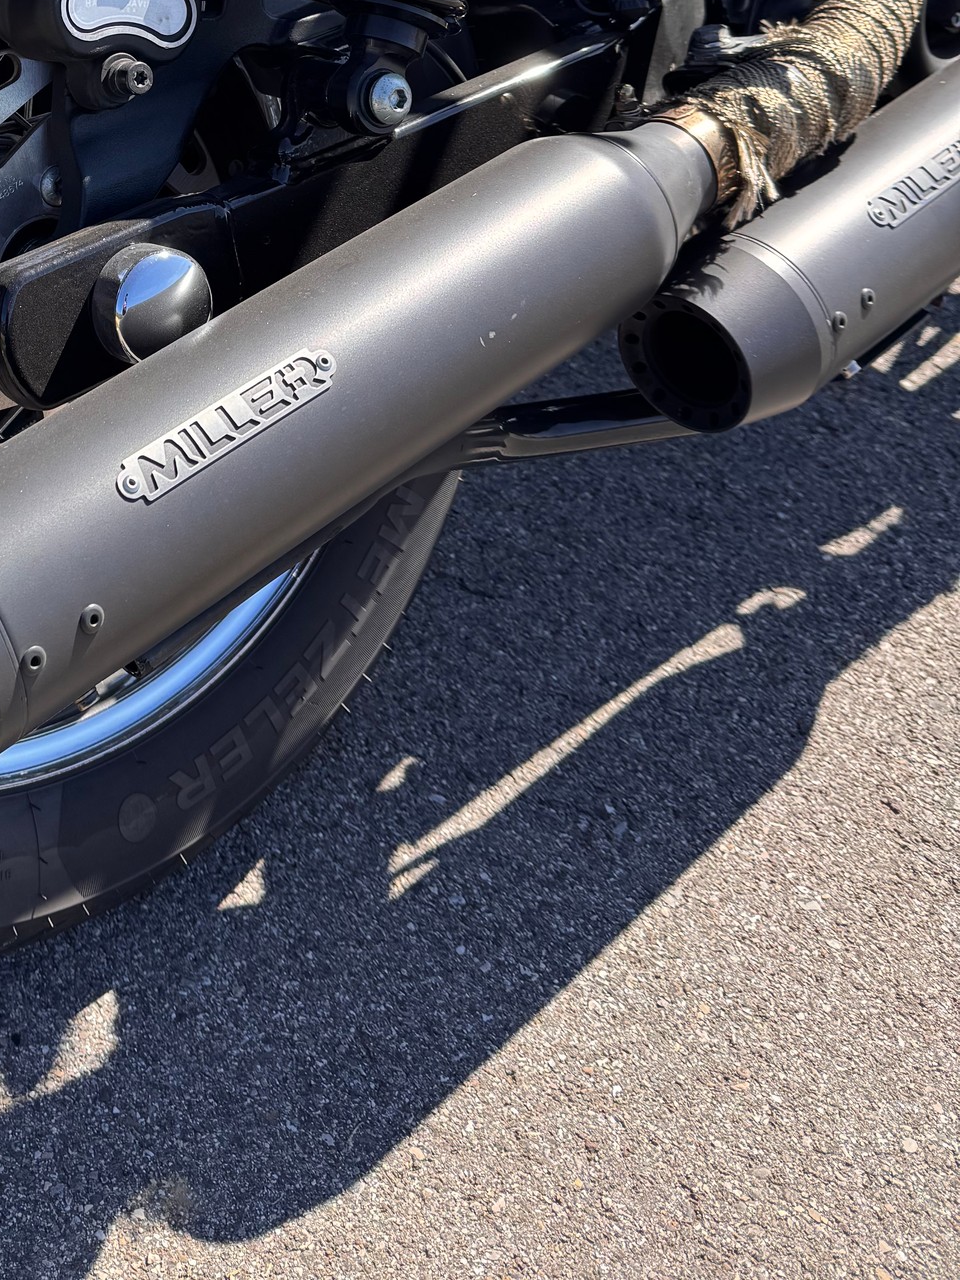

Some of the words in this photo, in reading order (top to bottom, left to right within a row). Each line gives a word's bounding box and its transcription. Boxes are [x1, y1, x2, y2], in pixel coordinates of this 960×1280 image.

[877, 139, 960, 221] MILLE
[137, 355, 327, 494] MILLER
[167, 483, 426, 811] METZELER
